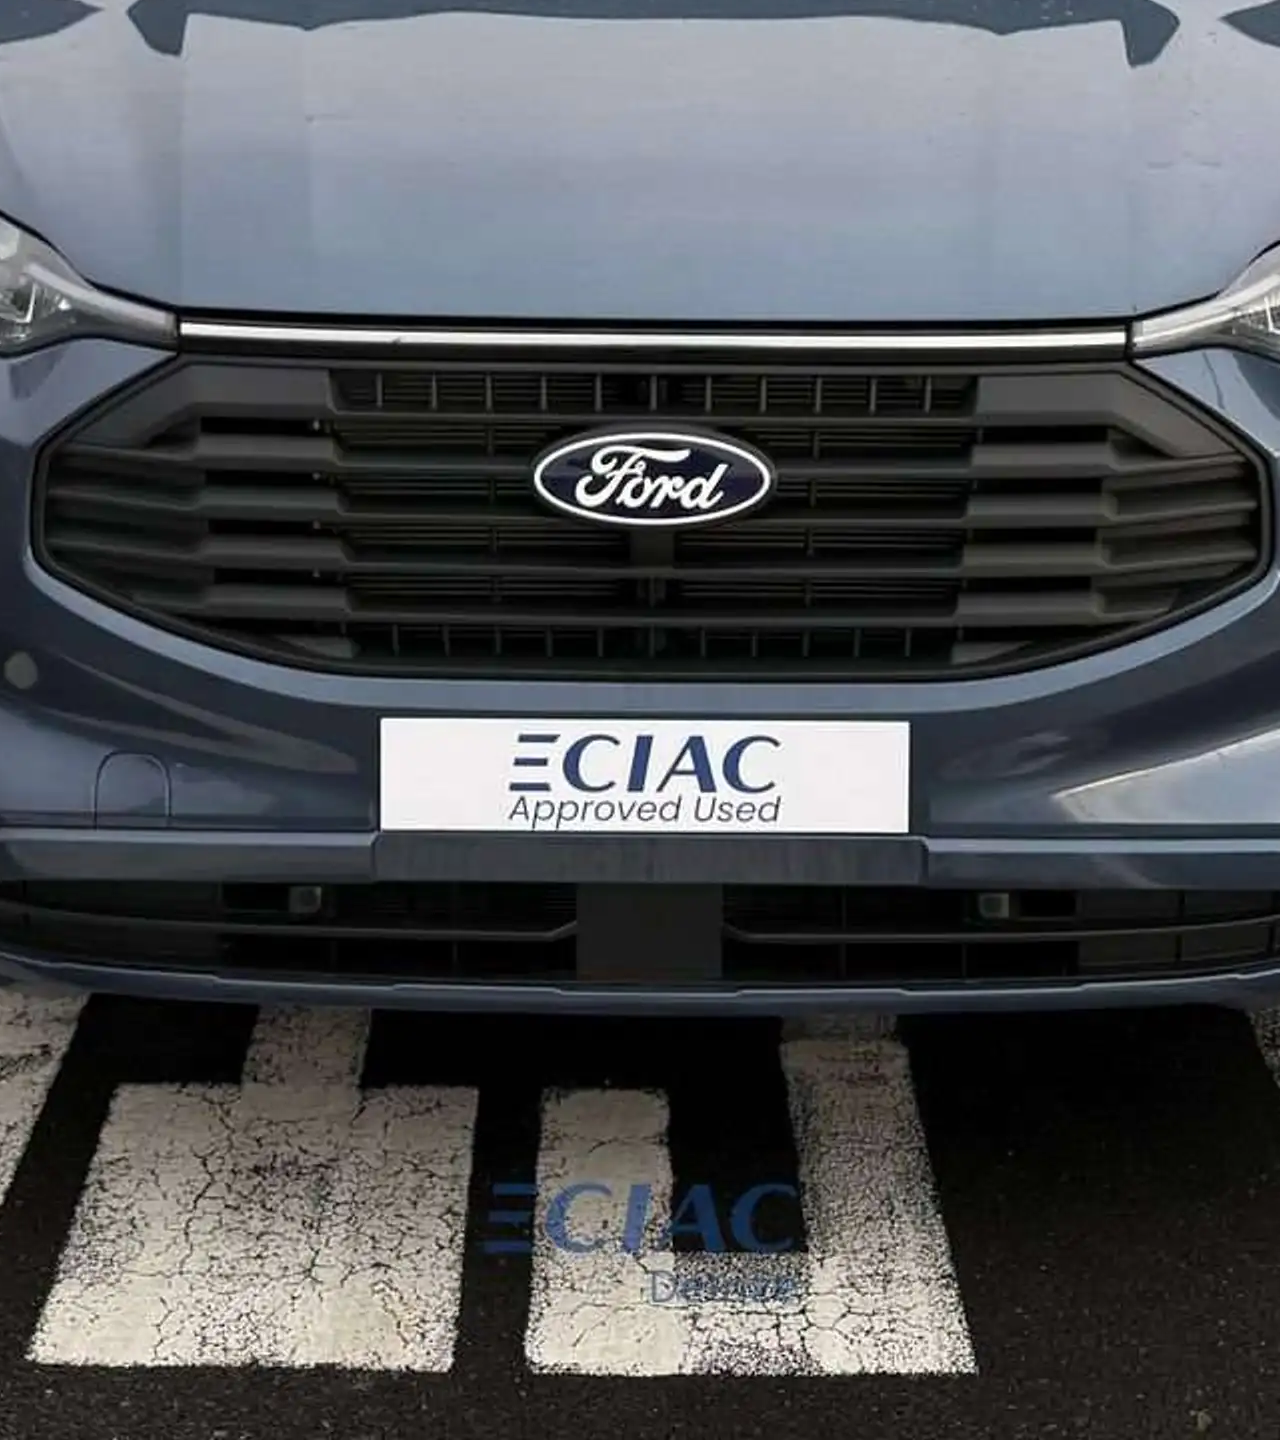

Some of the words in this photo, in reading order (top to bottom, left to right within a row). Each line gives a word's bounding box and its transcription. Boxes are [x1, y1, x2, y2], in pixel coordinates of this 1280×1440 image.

[574, 444, 729, 510] Ford
[509, 733, 783, 794] ECIAC
[508, 794, 682, 830] Approved
[693, 795, 782, 823] Used
